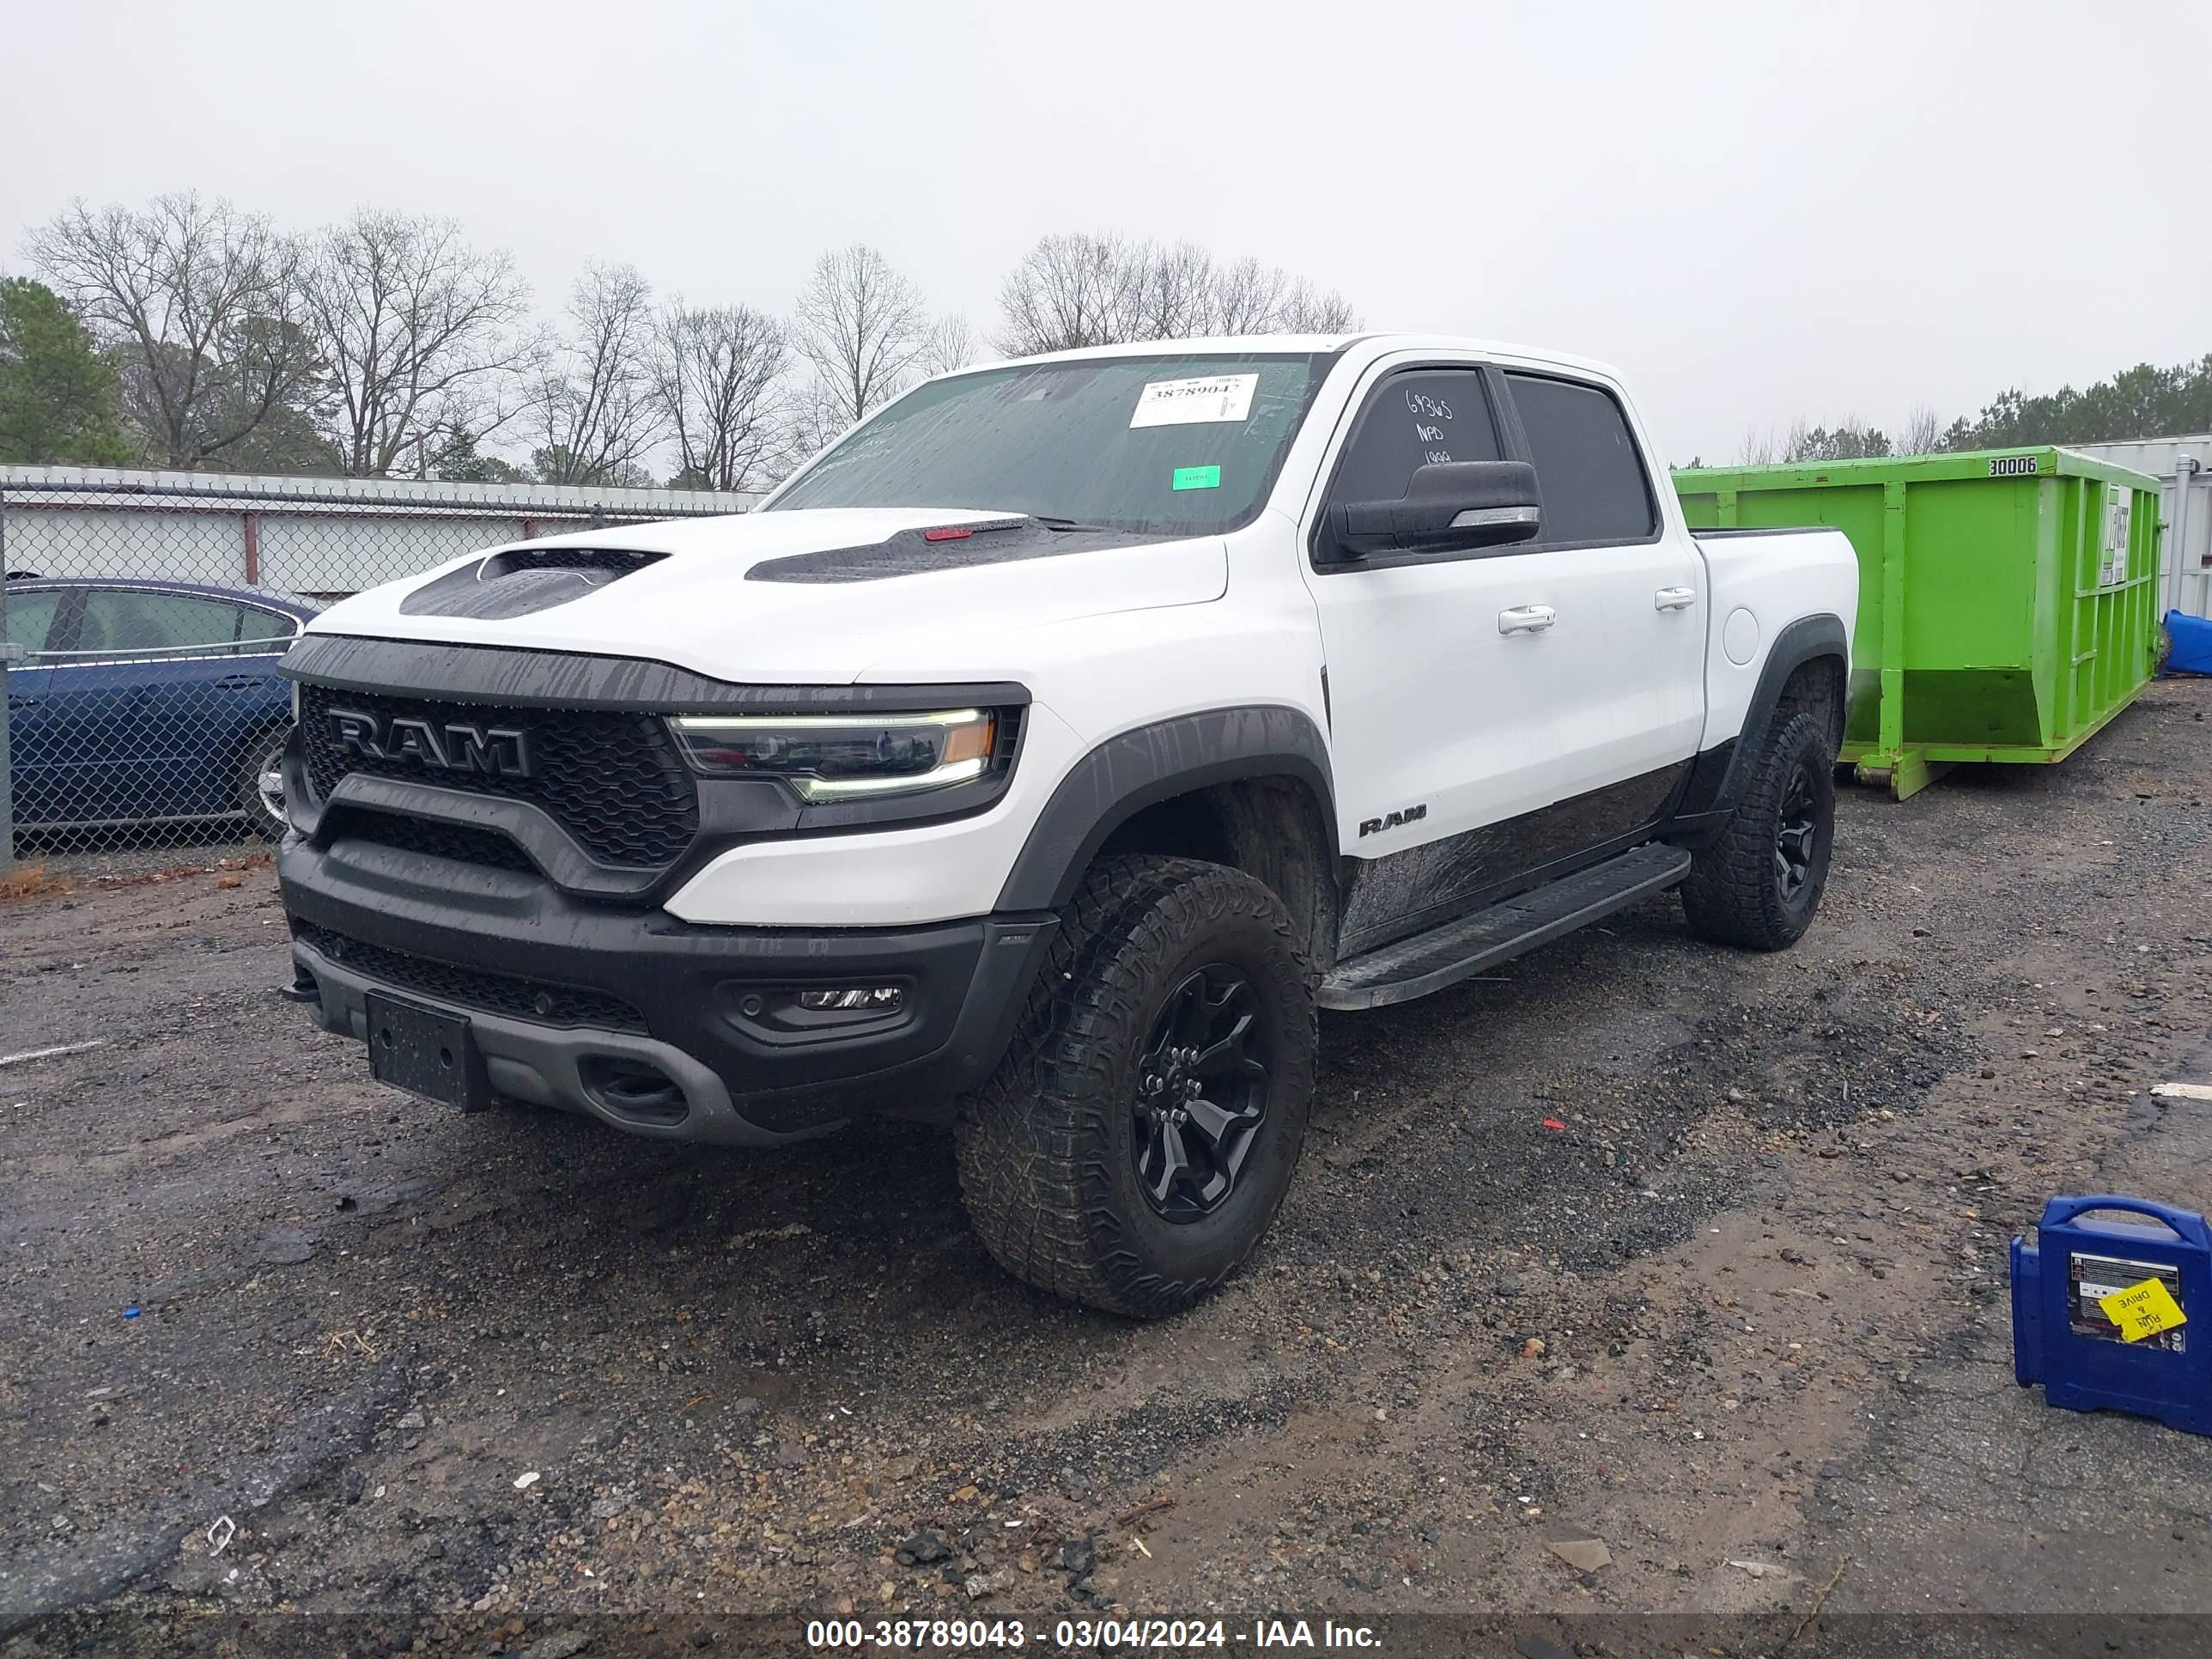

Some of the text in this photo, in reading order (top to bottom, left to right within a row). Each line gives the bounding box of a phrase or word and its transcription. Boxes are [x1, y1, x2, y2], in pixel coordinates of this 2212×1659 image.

[1989, 456, 2038, 477] 30006
[328, 708, 530, 776] RAM
[1358, 803, 1426, 838] RAM
[2117, 1290, 2151, 1309] DRIVE
[2136, 1314, 2162, 1328] RUN
